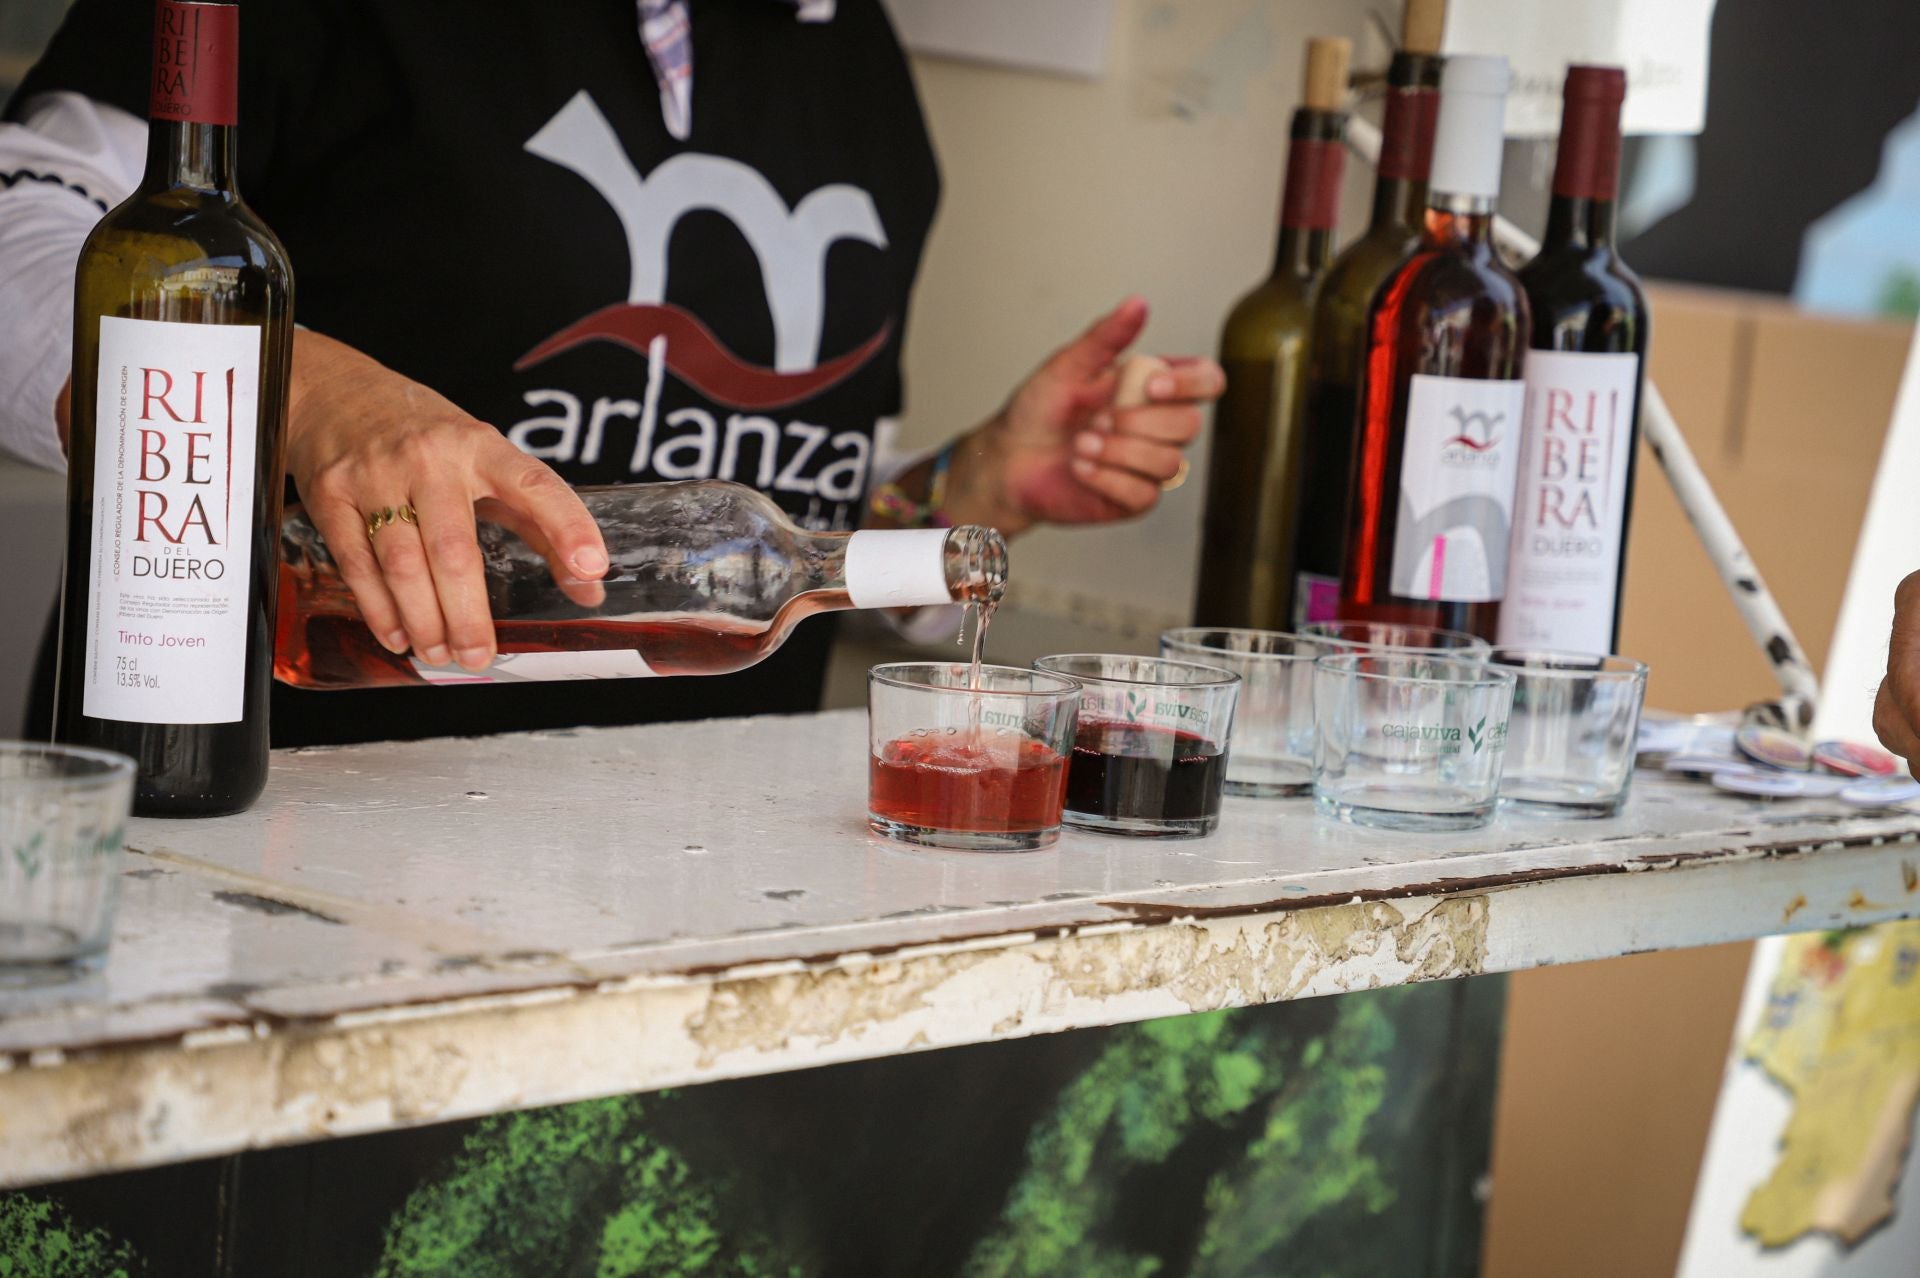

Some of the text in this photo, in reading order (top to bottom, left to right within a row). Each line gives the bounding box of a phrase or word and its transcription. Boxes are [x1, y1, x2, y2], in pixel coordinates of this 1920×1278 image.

[120, 395, 127, 406] DE
[138, 367, 207, 424] RI
[506, 337, 870, 500] arlanza
[135, 428, 213, 485] BE
[117, 470, 124, 480] LA
[117, 481, 124, 491] DE
[115, 493, 123, 538] REGULADOR
[133, 489, 222, 545] RA
[113, 540, 121, 576] CONSEJO
[163, 546, 192, 556] DEL
[133, 555, 225, 580] DUERO
[118, 630, 206, 648] Tinto Joven
[116, 656, 137, 671] 75 cl
[143, 674, 160, 689] Vol.
[1382, 721, 1461, 743] cajaviva
